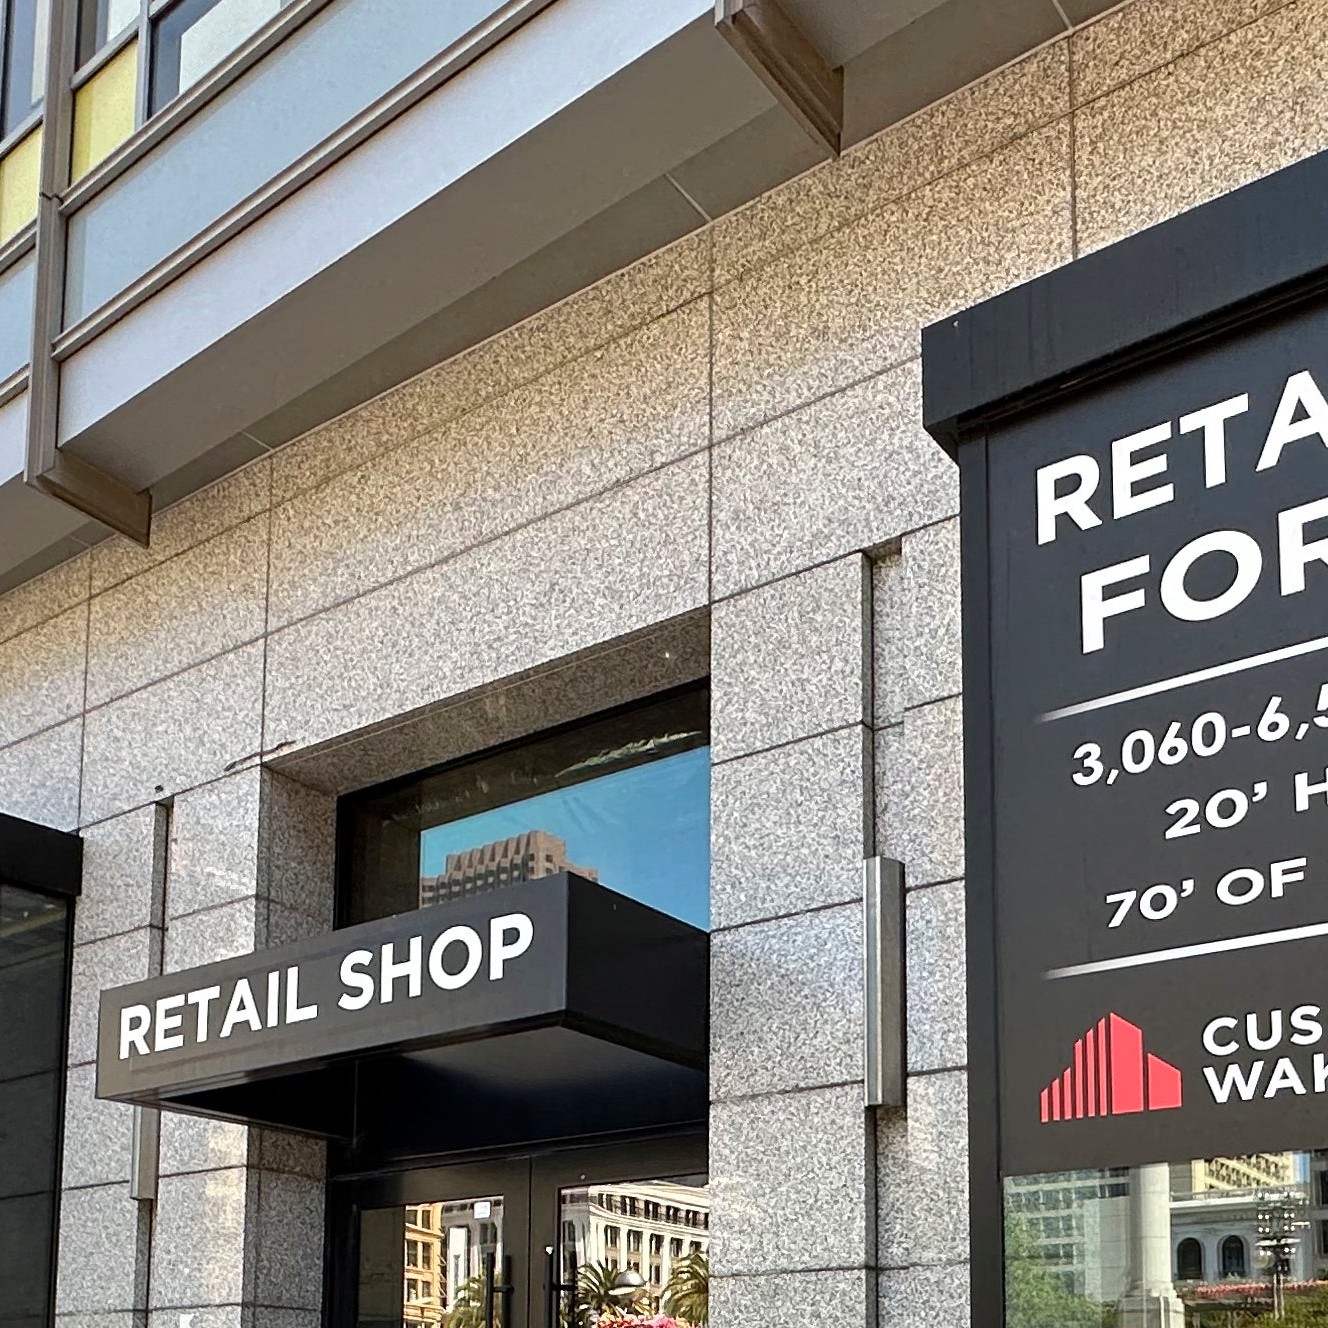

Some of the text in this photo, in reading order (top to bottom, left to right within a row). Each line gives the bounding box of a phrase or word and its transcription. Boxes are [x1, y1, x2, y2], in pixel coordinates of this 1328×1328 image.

[1215, 857, 1308, 907] OF
[118, 911, 534, 1060] RETAIL SHOP
